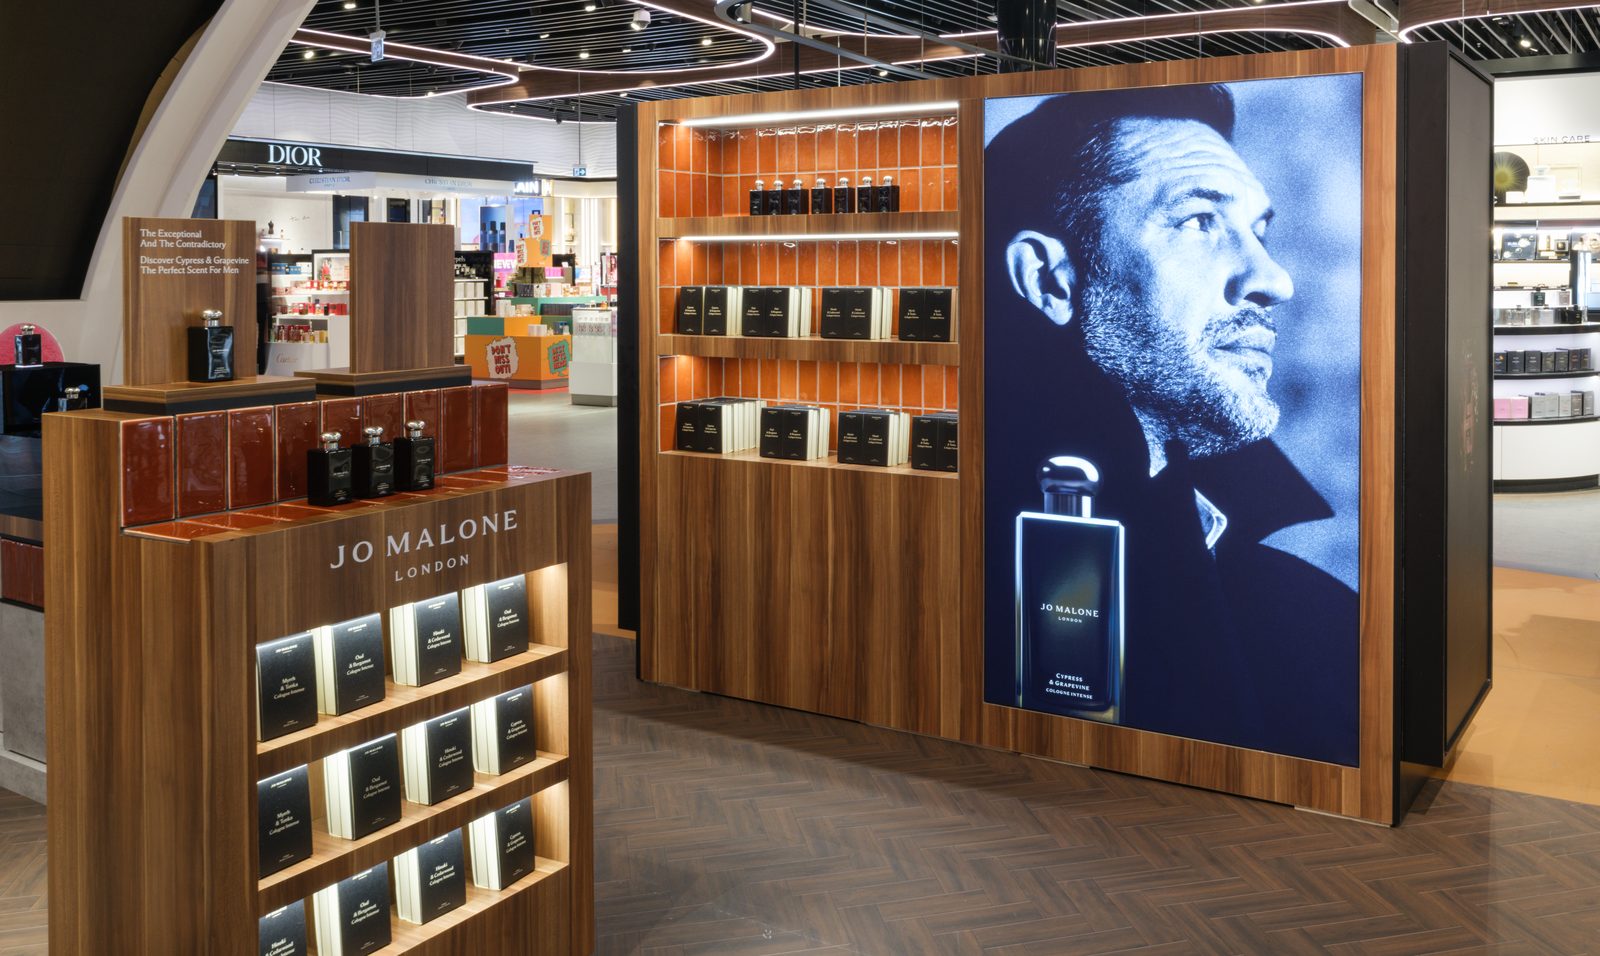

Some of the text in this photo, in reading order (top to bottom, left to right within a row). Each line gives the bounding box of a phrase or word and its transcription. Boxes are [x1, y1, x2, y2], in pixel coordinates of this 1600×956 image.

[1561, 134, 1590, 142] CARE
[268, 144, 322, 166] DIOR
[140, 228, 202, 239] The Exceptional
[140, 240, 226, 250] And The Contradictory
[140, 256, 250, 266] Discover Cypress & Grapevine
[140, 266, 239, 274] The Perfect Scent For Men
[491, 344, 512, 354] DON'T
[494, 354, 510, 365] MISS
[495, 364, 511, 374] OUT!
[330, 509, 518, 569] JO MALONE
[395, 554, 469, 582] LONDON
[1040, 603, 1099, 618] JO MALONE
[355, 653, 364, 661] Oud
[1056, 673, 1083, 682] CYPRESS
[1055, 680, 1090, 691] GRAPEVINE
[1046, 688, 1070, 696] COLOGNE
[360, 899, 370, 908] Oud
[271, 937, 286, 949] Hinoki
